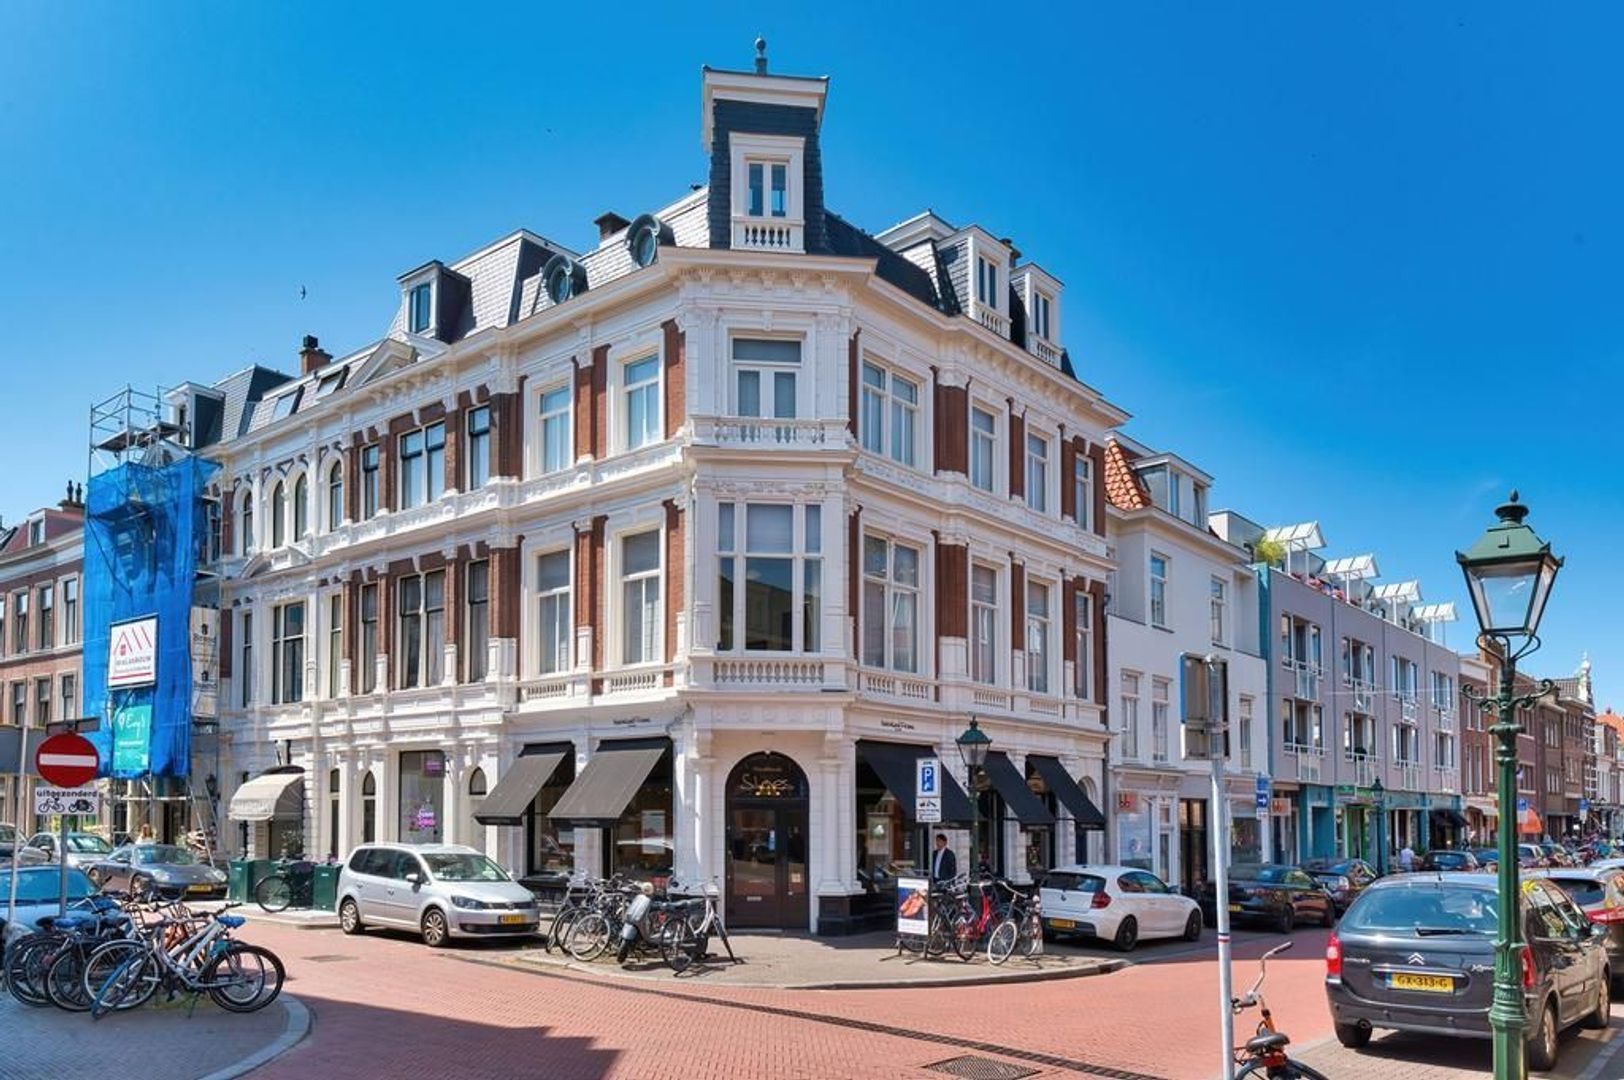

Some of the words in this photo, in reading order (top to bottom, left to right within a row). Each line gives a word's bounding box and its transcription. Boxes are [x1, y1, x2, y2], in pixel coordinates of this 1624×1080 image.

[924, 768, 933, 781] P
[36, 790, 98, 799] uitgezonderd
[1397, 976, 1448, 988] GX-313-G
